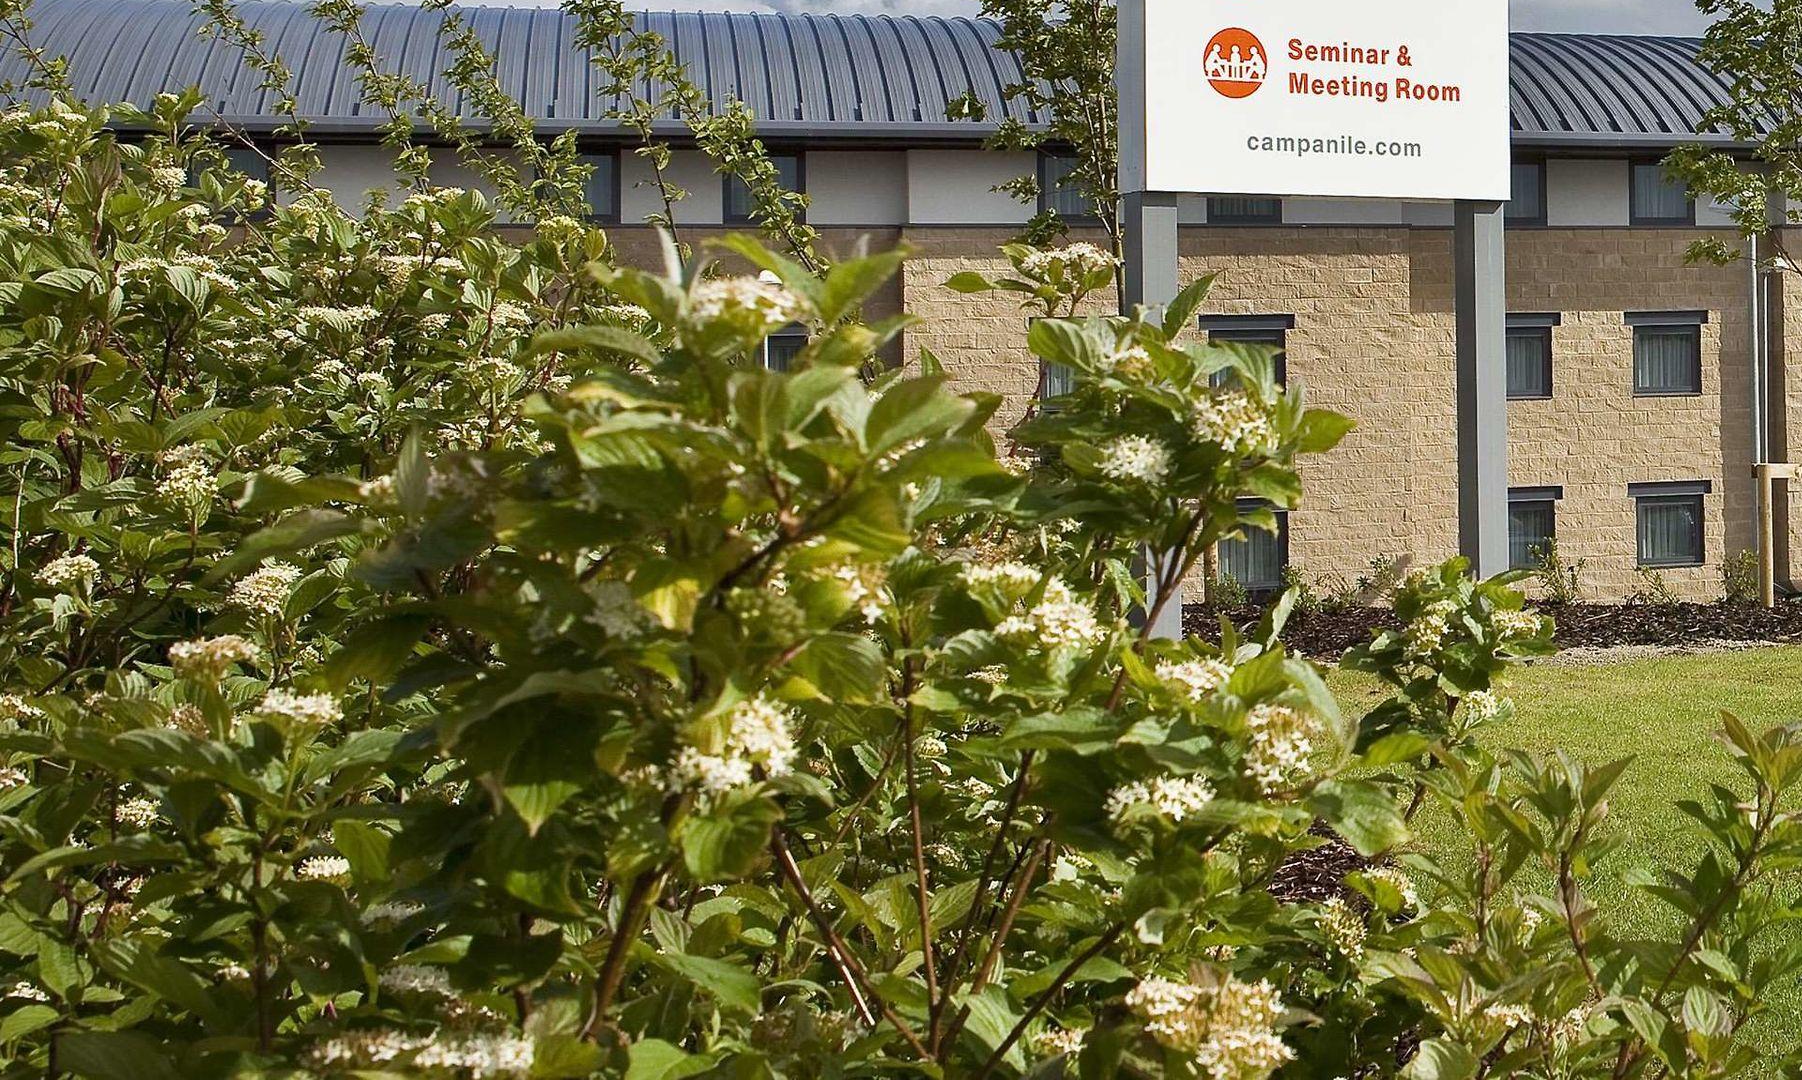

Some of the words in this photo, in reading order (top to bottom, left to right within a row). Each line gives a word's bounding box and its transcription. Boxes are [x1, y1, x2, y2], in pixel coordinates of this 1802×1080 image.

[1287, 37, 1391, 66] Seminar
[1396, 44, 1413, 67] &
[1288, 71, 1389, 103] Meeting
[1395, 77, 1461, 103] Room
[1246, 134, 1422, 158] campanile.com
